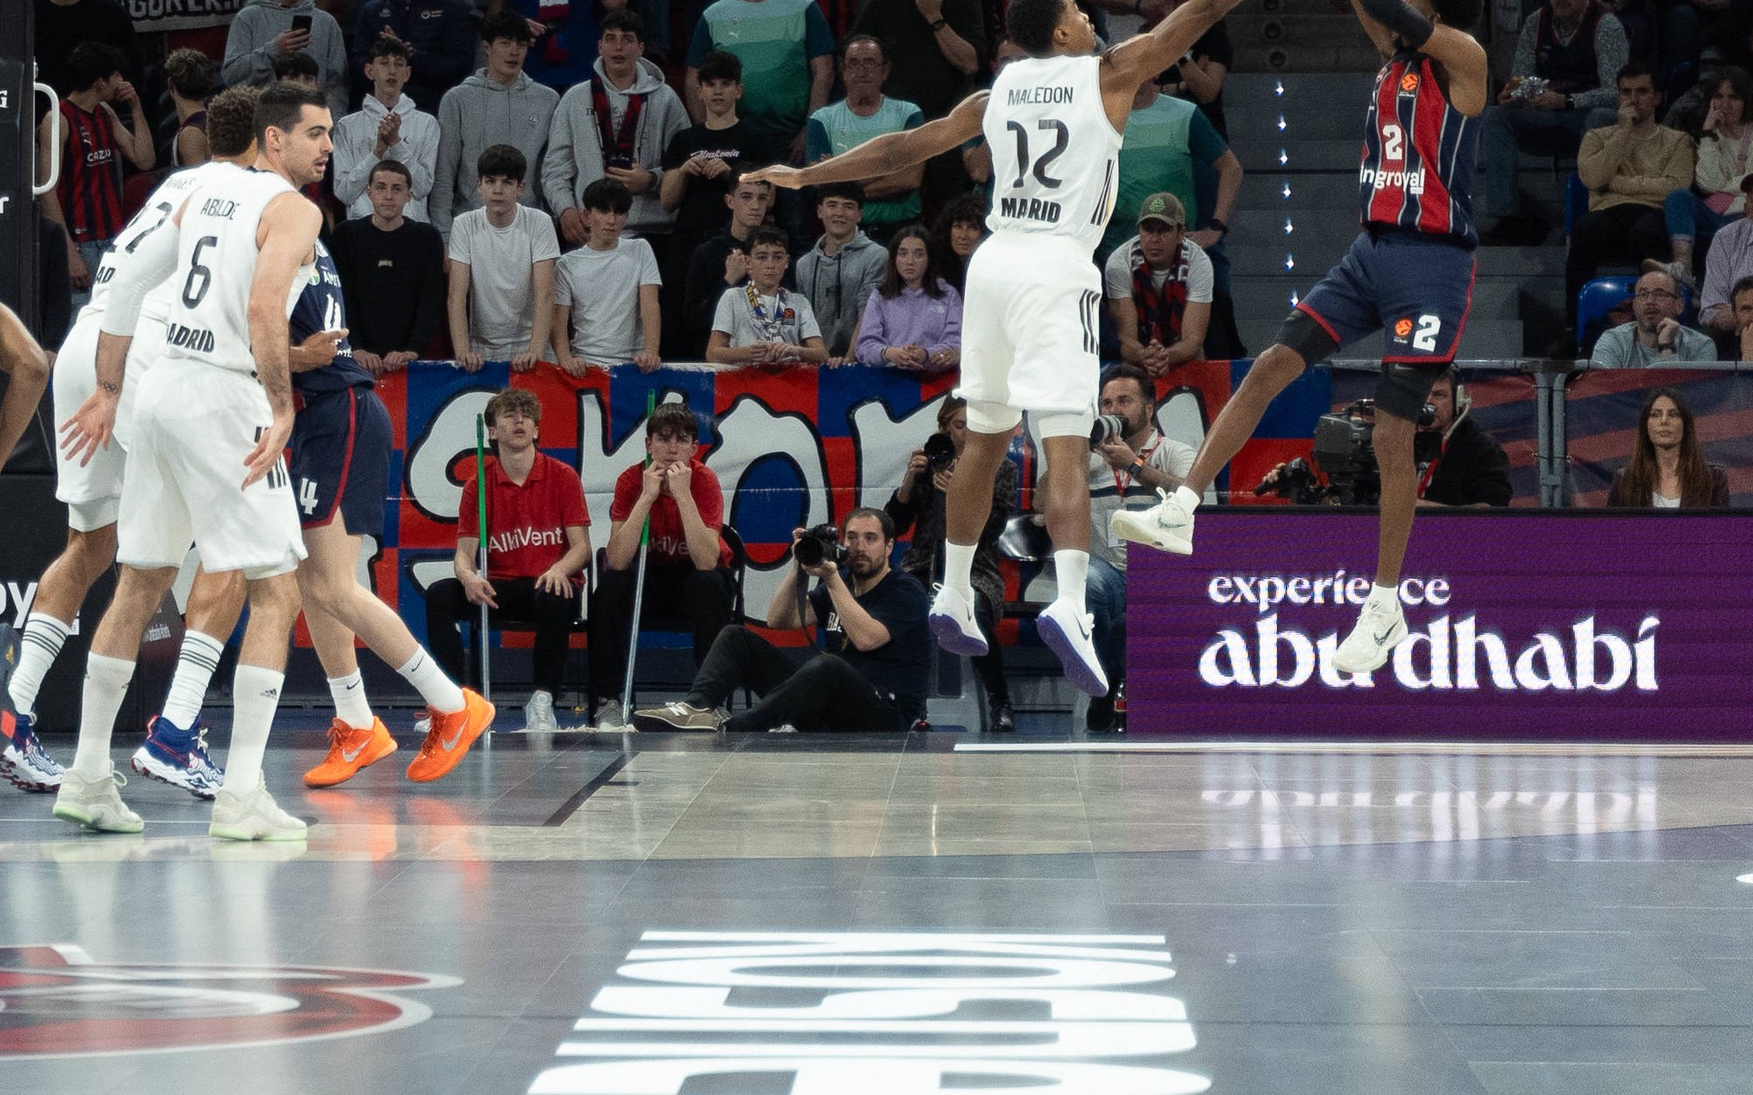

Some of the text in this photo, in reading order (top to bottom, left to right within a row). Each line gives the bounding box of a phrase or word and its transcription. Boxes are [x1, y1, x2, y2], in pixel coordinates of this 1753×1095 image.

[1007, 86, 1074, 107] MALEDON
[1006, 118, 1070, 190] 12
[1382, 124, 1404, 161] 2
[182, 235, 219, 311] 6
[1412, 314, 1442, 353] 2
[299, 476, 318, 511] 4
[487, 526, 565, 554] AlkiVent
